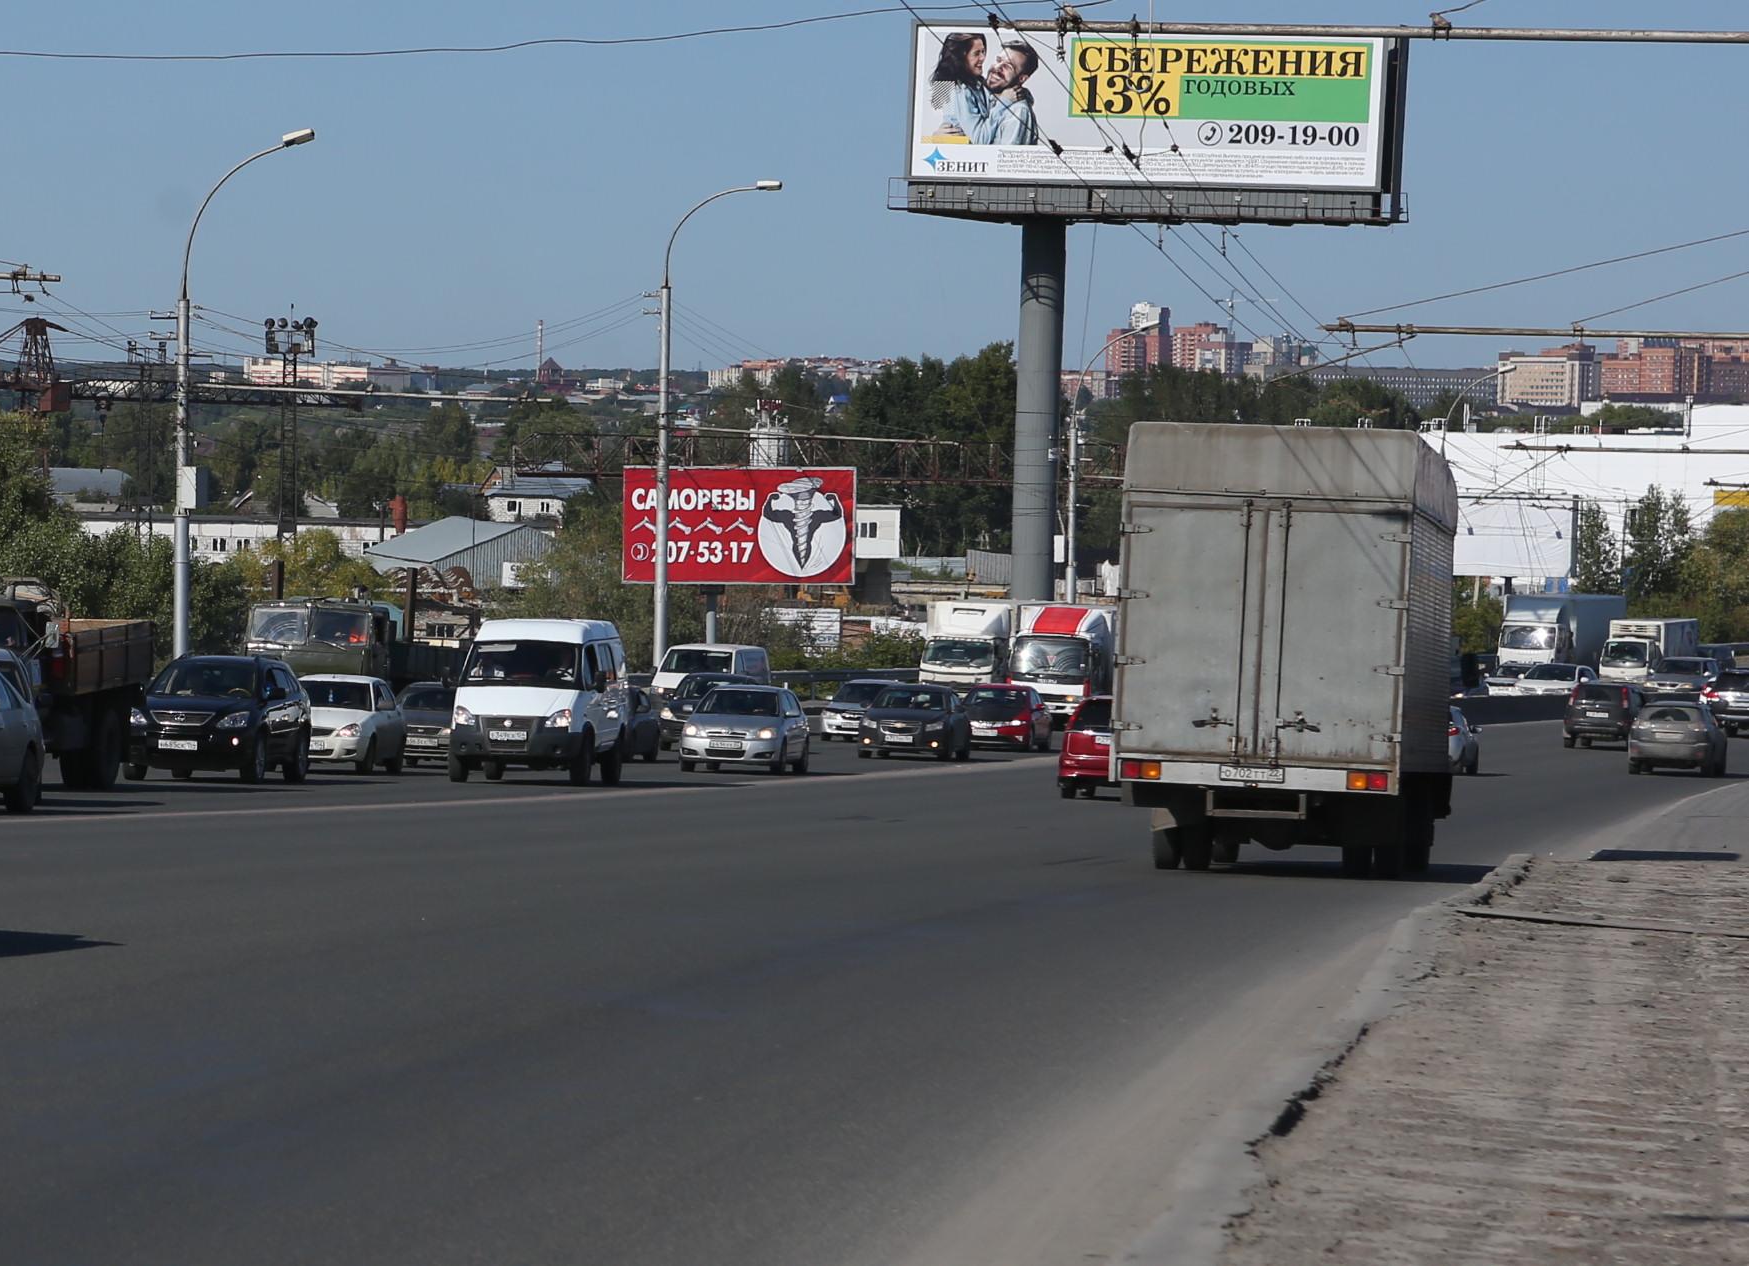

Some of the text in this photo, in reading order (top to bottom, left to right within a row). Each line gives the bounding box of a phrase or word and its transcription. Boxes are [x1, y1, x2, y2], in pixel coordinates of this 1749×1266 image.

[1078, 46, 1366, 78] СБЕРЕЖЕНИЯ
[1080, 74, 1171, 115] 13%
[1184, 79, 1295, 98] ГОДОВЫХ
[1228, 124, 1360, 146] 209-19-00
[937, 161, 989, 173] ЗЕНИТ
[631, 488, 755, 511] САМОРЕЗЫ
[1224, 767, 1267, 780] О702ТТ
